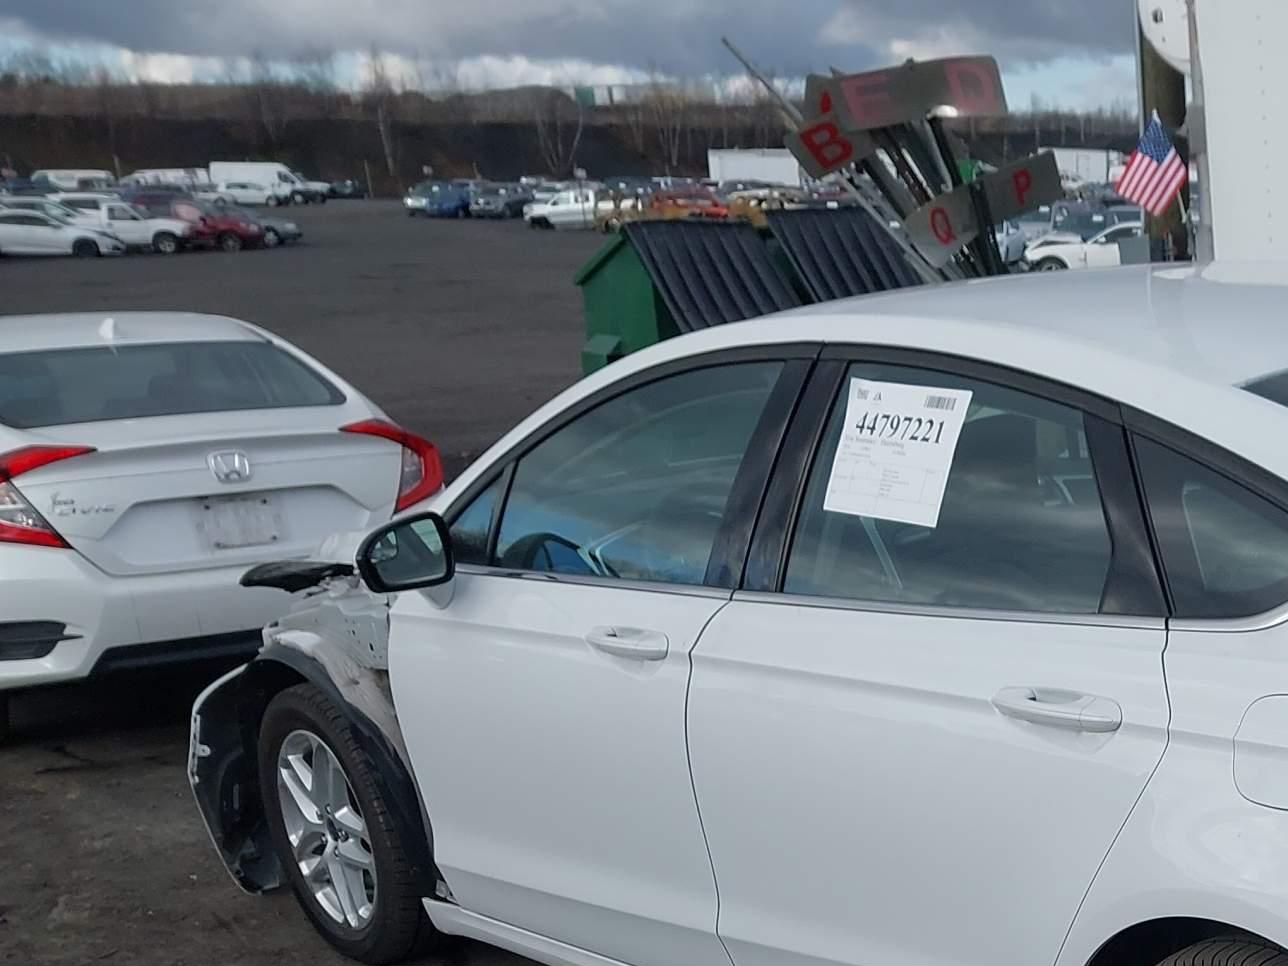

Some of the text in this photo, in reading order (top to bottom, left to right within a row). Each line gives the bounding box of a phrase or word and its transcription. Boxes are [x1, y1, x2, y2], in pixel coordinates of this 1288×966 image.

[800, 122, 854, 170] B
[1013, 168, 1031, 207] P
[930, 206, 957, 246] Q
[855, 412, 945, 444] 44797221
